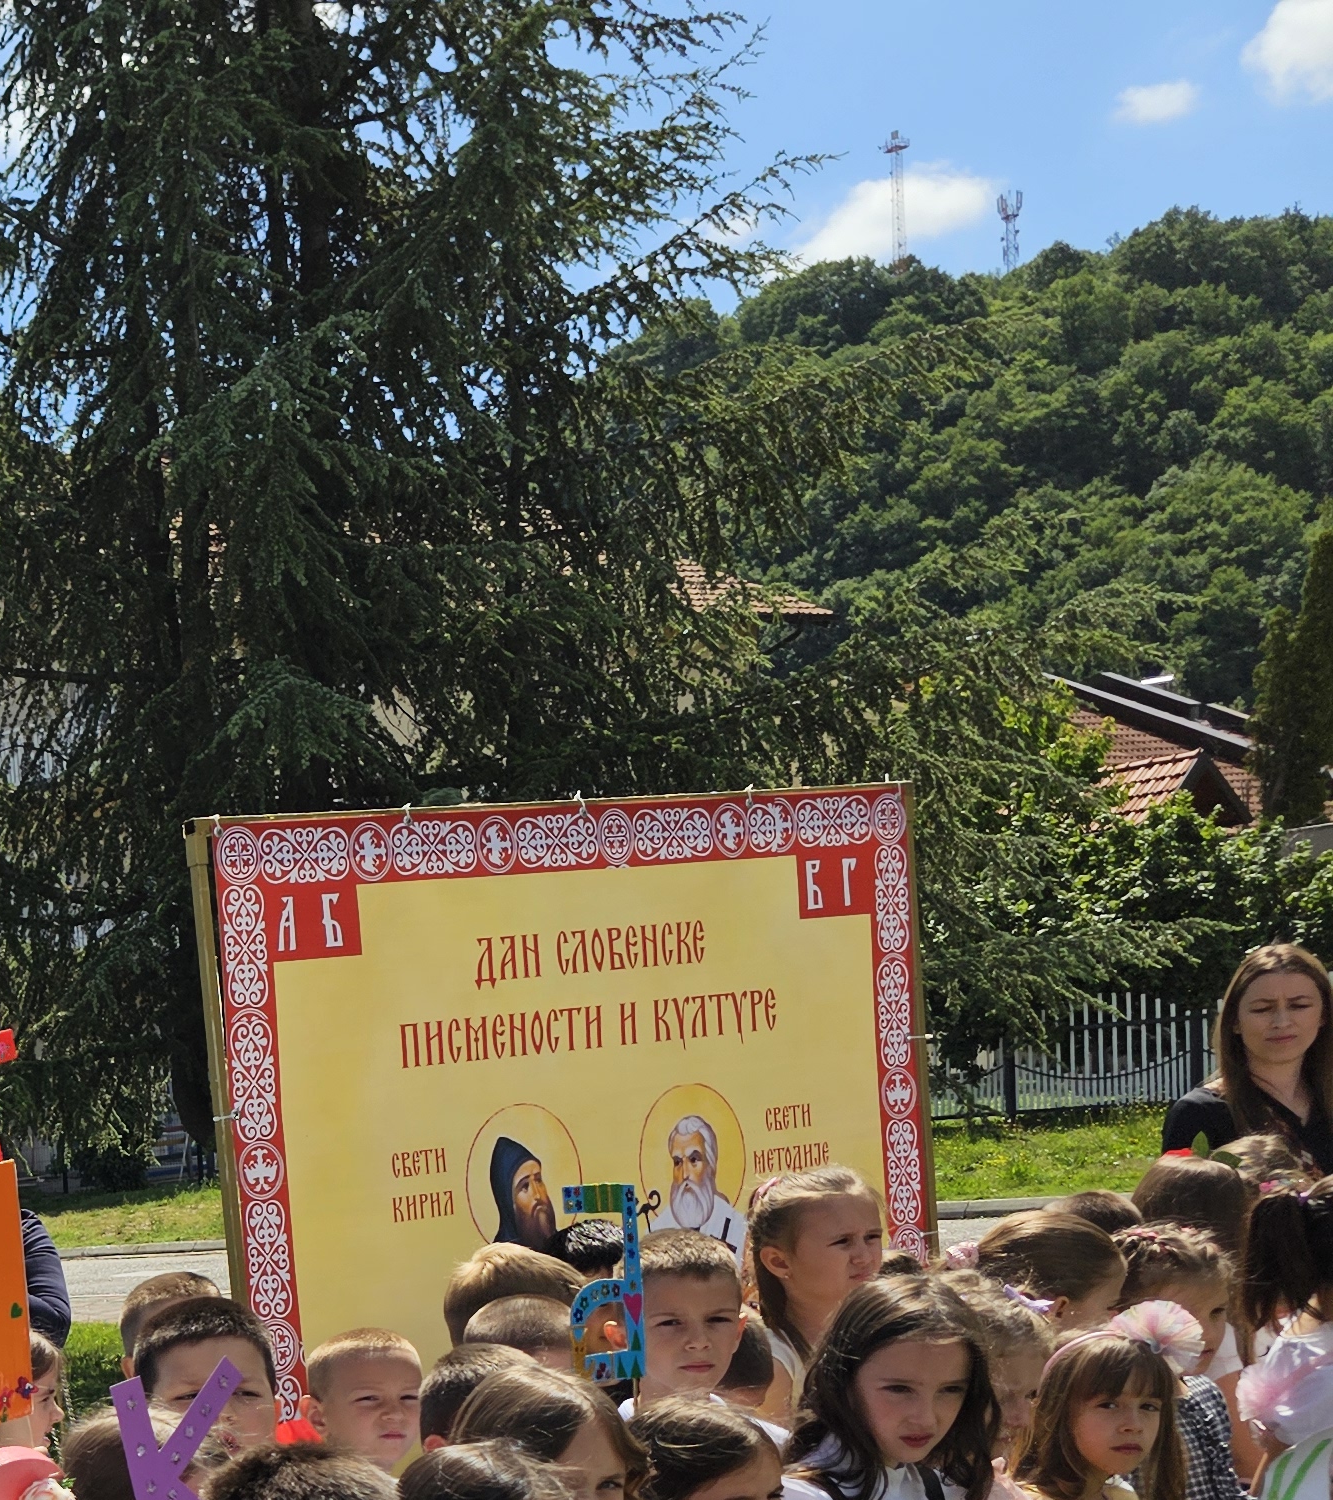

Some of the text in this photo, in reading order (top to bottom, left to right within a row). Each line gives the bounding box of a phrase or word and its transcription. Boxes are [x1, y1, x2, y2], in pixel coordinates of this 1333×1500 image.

[841, 858, 857, 906] Г
[321, 893, 344, 948] Б
[475, 920, 706, 990] ДАН СЛОВЕНСКЕ
[399, 988, 777, 1069] ПИСМЕНОСТИ И КУЛТУРЕ
[765, 1103, 812, 1132] СВЕТИ
[391, 1147, 447, 1178] СВЕТИ
[753, 1141, 829, 1174] МЕТОДИЈЕ
[392, 1190, 454, 1223] КИРИЛ
